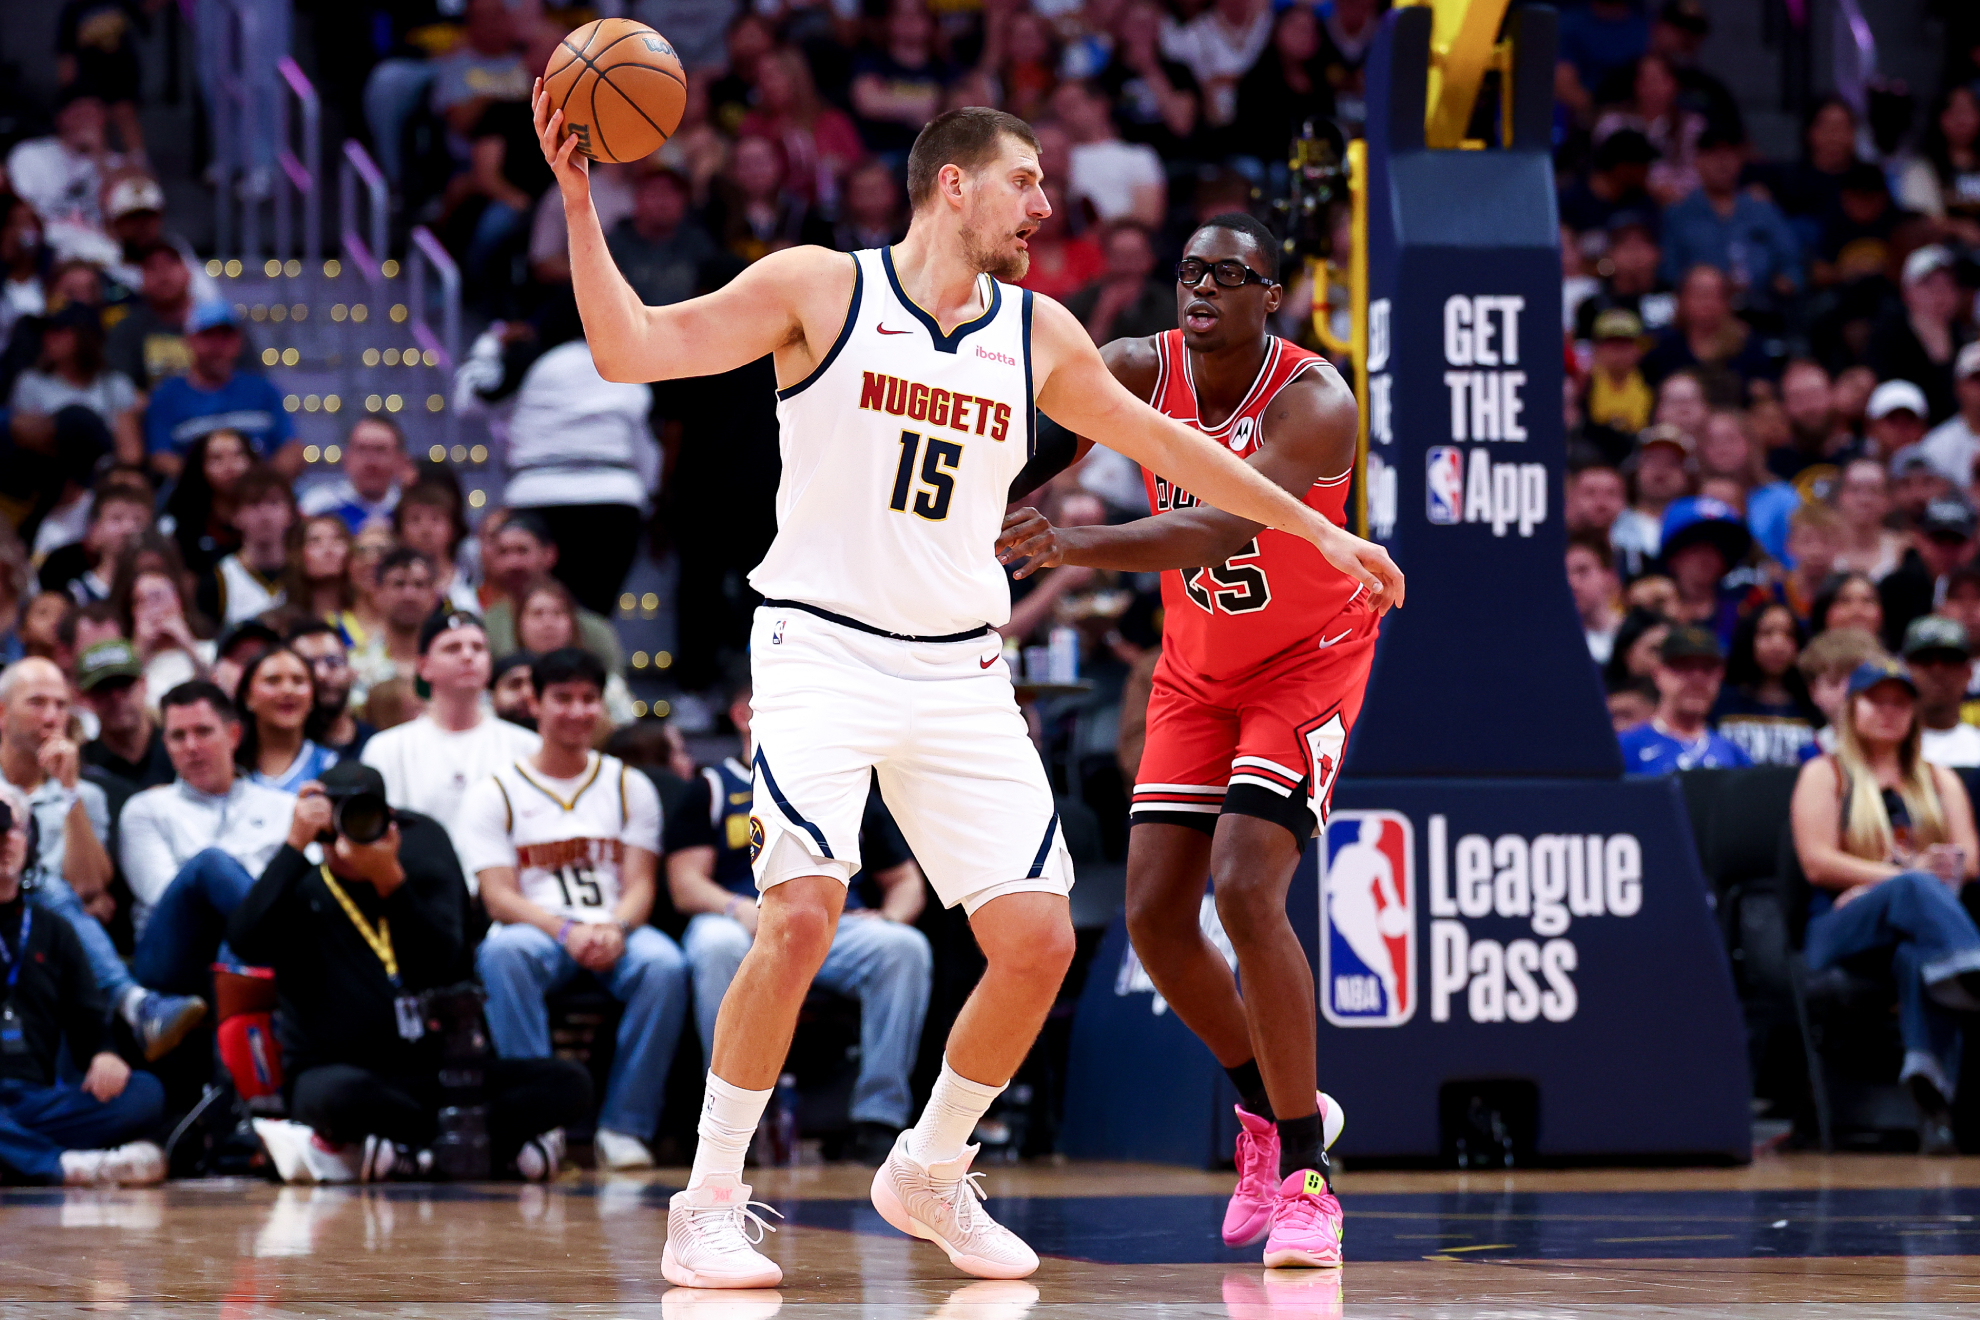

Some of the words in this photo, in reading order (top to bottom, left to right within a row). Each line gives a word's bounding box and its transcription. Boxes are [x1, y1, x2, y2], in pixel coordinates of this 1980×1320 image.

[975, 345, 1016, 367] ibotta
[1443, 294, 1525, 367] GET
[858, 370, 1012, 442] NUGGETS
[1443, 370, 1527, 442] THE
[888, 428, 965, 522] 15
[1464, 447, 1548, 538] App
[554, 860, 603, 907] 15
[1427, 813, 1643, 937] League
[1335, 975, 1382, 1011] NBA
[1429, 918, 1578, 1023] Pass
